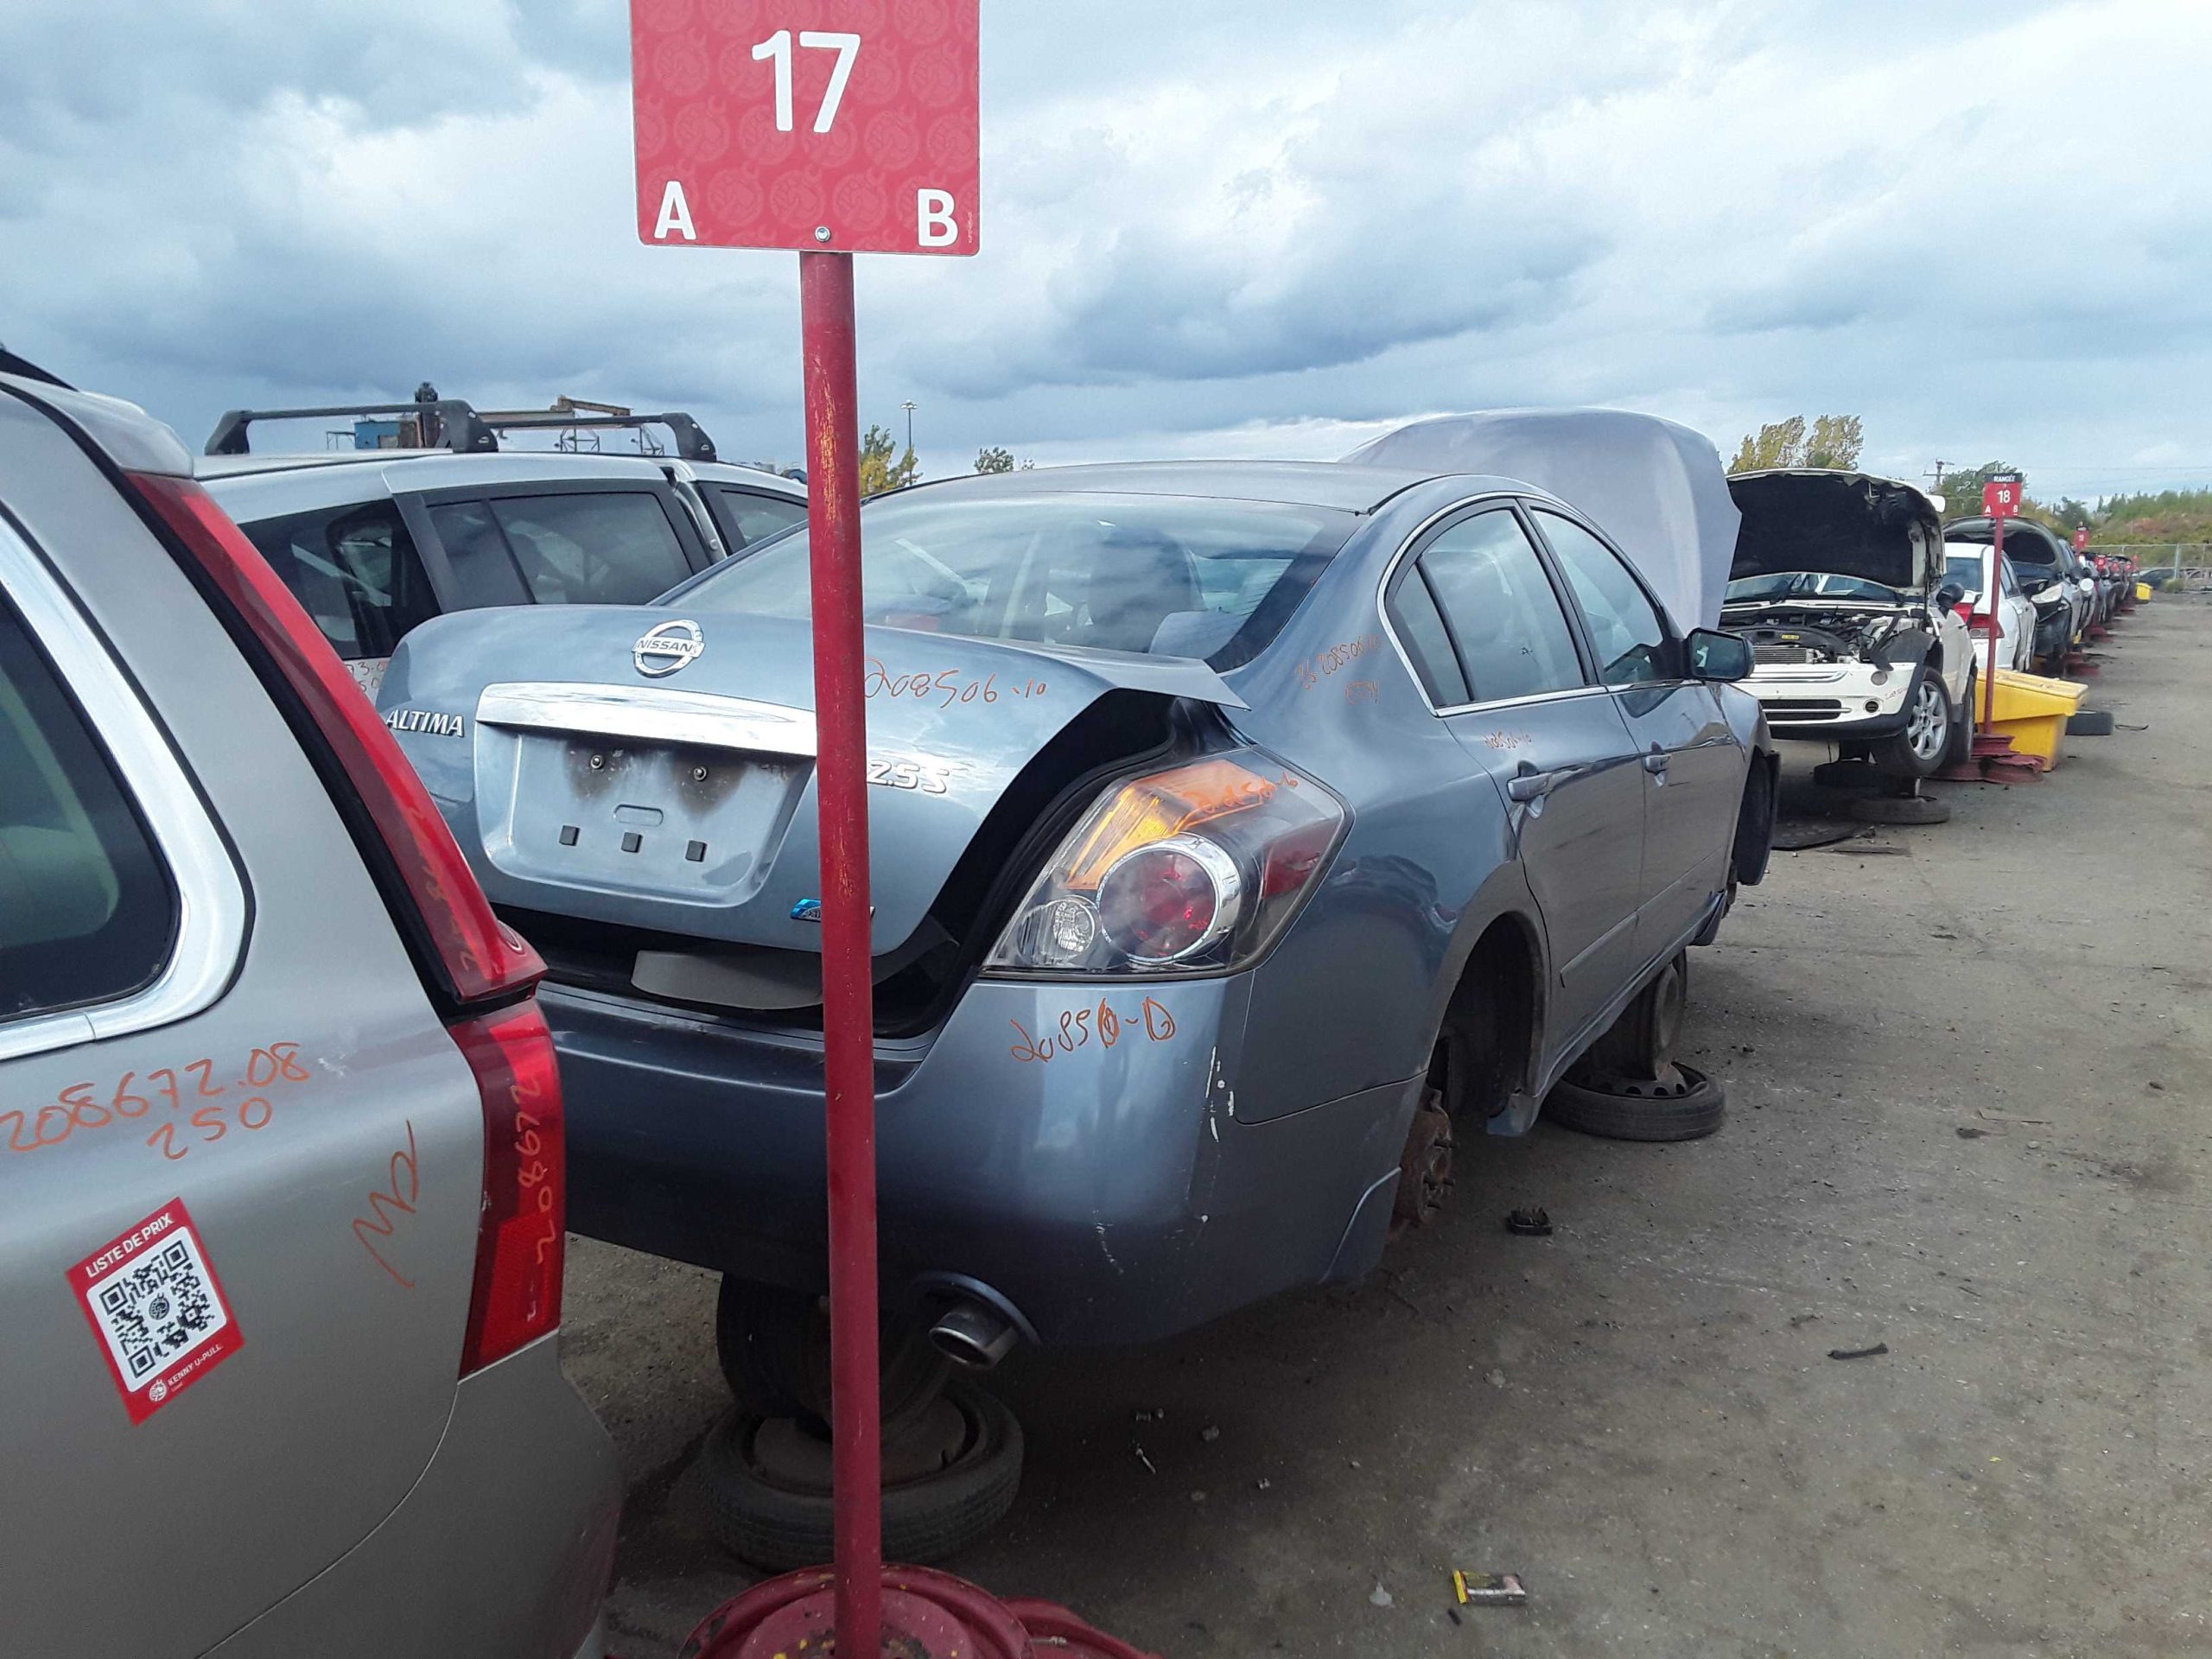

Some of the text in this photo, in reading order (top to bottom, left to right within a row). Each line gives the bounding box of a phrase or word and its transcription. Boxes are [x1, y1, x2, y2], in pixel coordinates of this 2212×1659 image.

[751, 29, 861, 133] 17
[653, 181, 697, 241] A
[916, 188, 959, 247] B
[1984, 505, 1992, 513] A
[1997, 489, 2011, 504] 18
[2013, 504, 2018, 513] B
[637, 639, 694, 652] NISSAN
[385, 709, 465, 738] ALTIMA
[147, 1096, 272, 1160] 250
[86, 1212, 175, 1278] LISTE DE PRIX
[168, 1363, 194, 1387] KENNY
[194, 1344, 224, 1366] U-PULL
